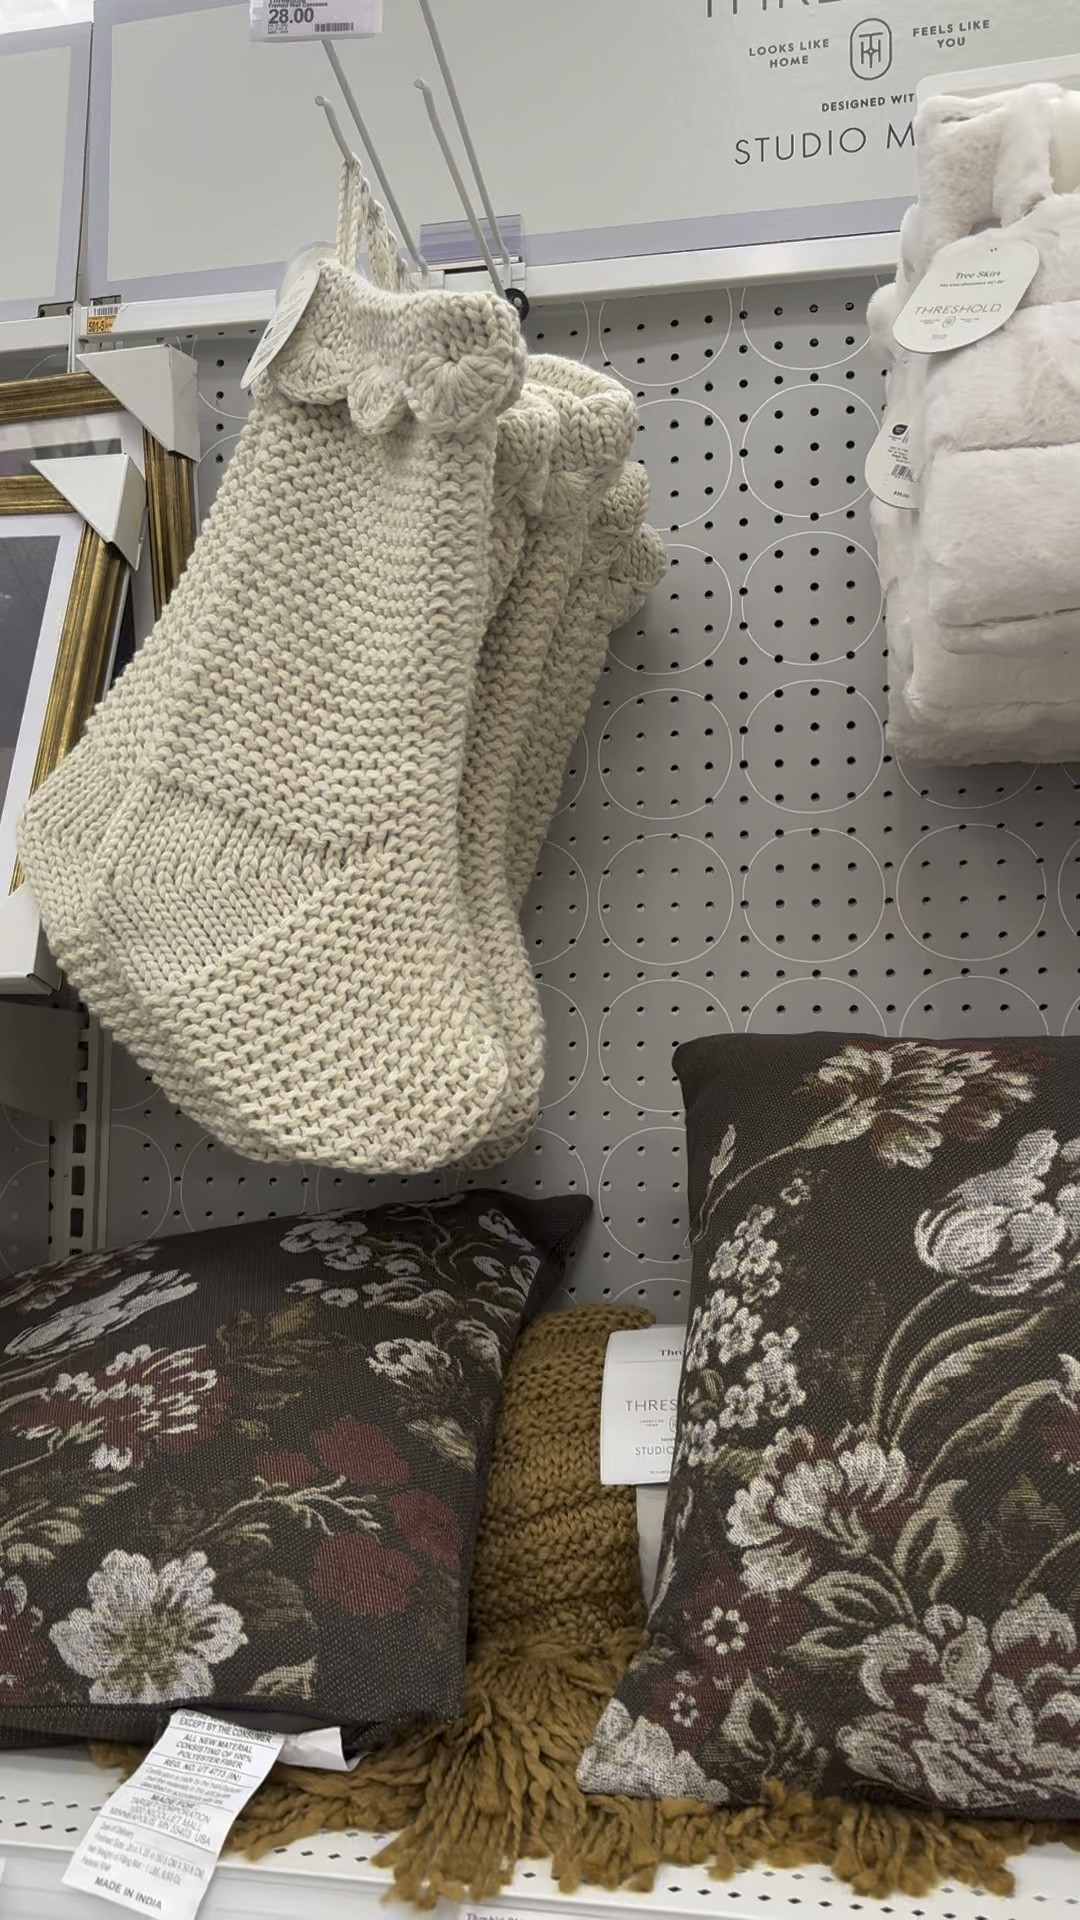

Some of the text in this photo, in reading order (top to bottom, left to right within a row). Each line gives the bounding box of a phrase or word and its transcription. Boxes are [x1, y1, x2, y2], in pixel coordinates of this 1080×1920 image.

[268, 8, 314, 24] 28.00
[912, 19, 990, 38] FEELS LIKE
[749, 38, 830, 57] LOOKS LIKE
[937, 36, 966, 50] YOU
[769, 55, 809, 69] HOME
[821, 93, 915, 113] DESIGNED WIT
[734, 127, 867, 165] STUDIO
[914, 304, 1002, 316] THRESHOLD
[626, 1400, 678, 1412] THRES
[180, 1717, 206, 1730] EXCEPT
[206, 1722, 217, 1732] BY
[219, 1725, 232, 1736] THE
[232, 1727, 272, 1743] CONSUMER
[176, 1741, 252, 1762] CONSISTING OF 100%
[184, 1734, 252, 1753] ALL NEW MATERIAL
[164, 1758, 181, 1768] REG.
[209, 1768, 227, 1778] 4773
[177, 1750, 243, 1769] POLYESTER FIBER
[152, 1794, 176, 1804] MADE
[156, 1802, 210, 1823] CORPORATION
[182, 1819, 201, 1832] MALL
[194, 1832, 212, 1846] USA
[94, 1876, 162, 1910] MADE IN INDIA
